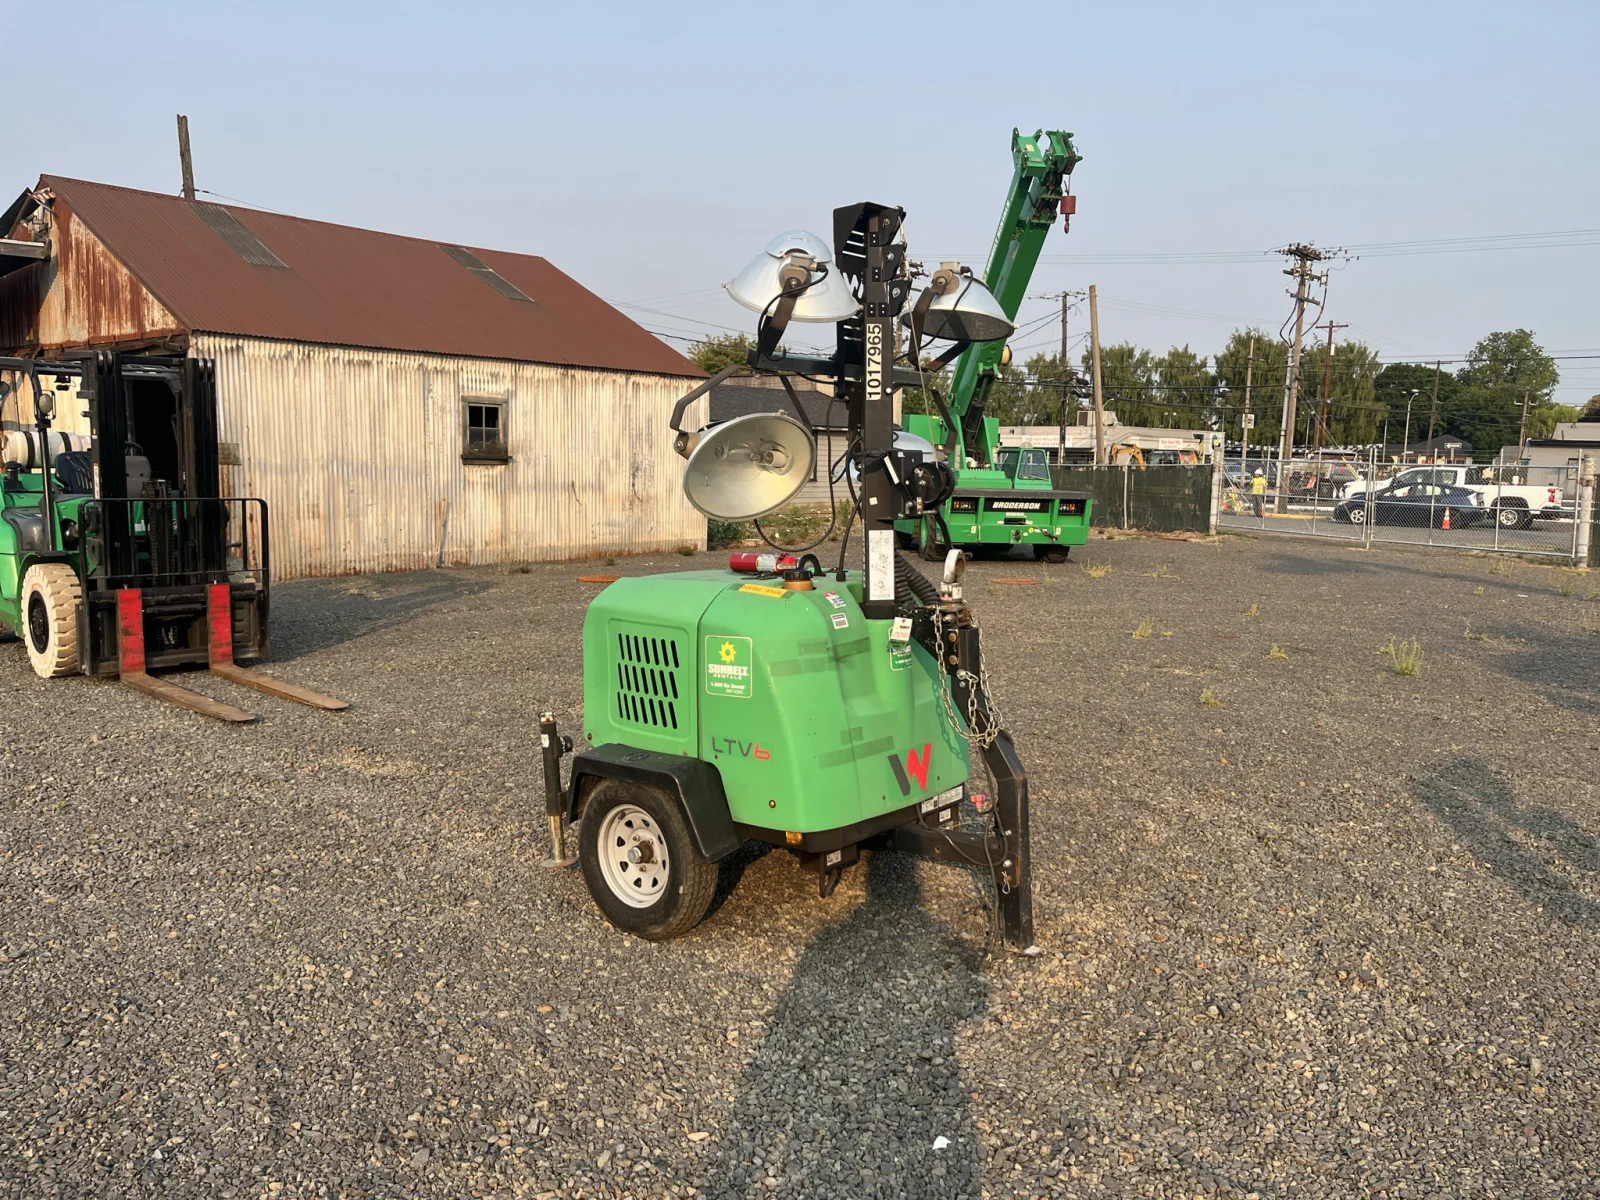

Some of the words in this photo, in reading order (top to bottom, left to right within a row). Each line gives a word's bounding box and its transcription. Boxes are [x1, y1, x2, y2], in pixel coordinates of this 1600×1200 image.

[867, 325, 882, 398] 1017965
[992, 501, 1041, 510] BRODERSON
[708, 664, 748, 676] SUNBELT
[712, 736, 771, 761] LTV6
